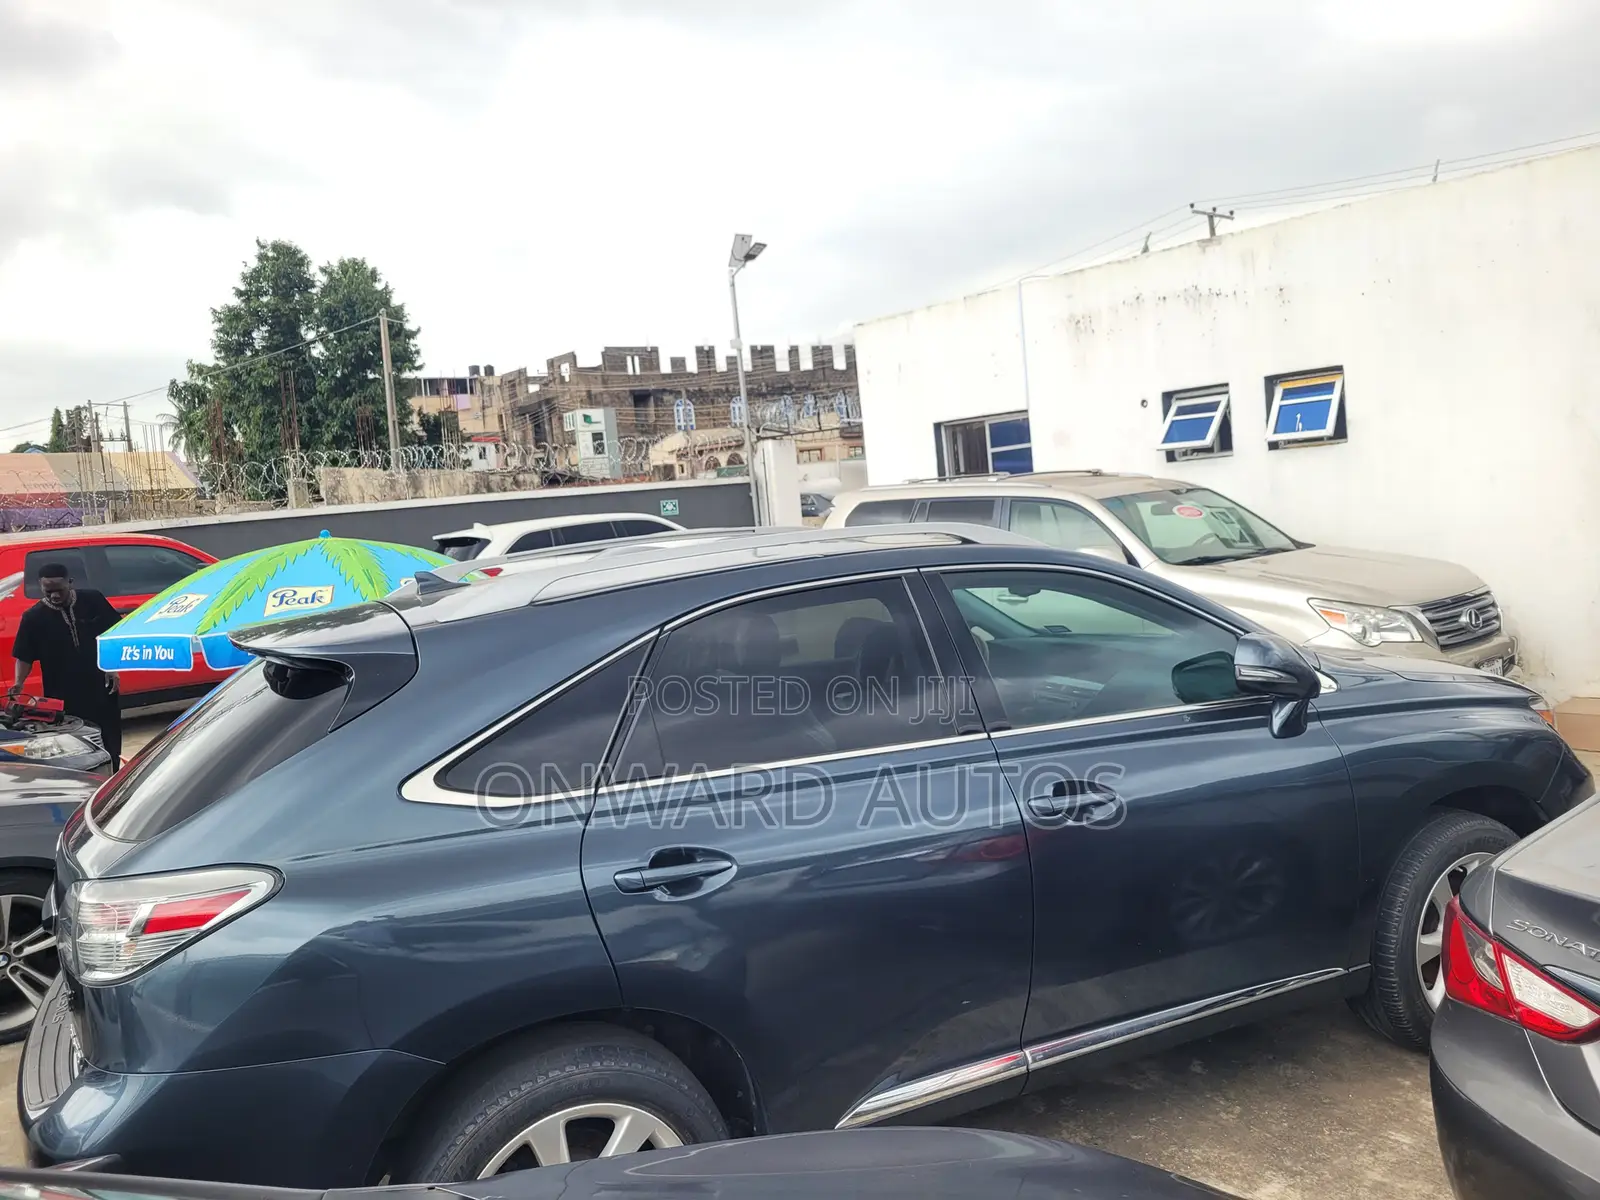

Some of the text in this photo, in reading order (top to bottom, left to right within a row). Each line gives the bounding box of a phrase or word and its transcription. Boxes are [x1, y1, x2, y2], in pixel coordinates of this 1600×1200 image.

[159, 595, 201, 614] Peak
[272, 588, 326, 608] Peak
[121, 644, 175, 661] It's in You
[1506, 919, 1600, 962] SONAT
